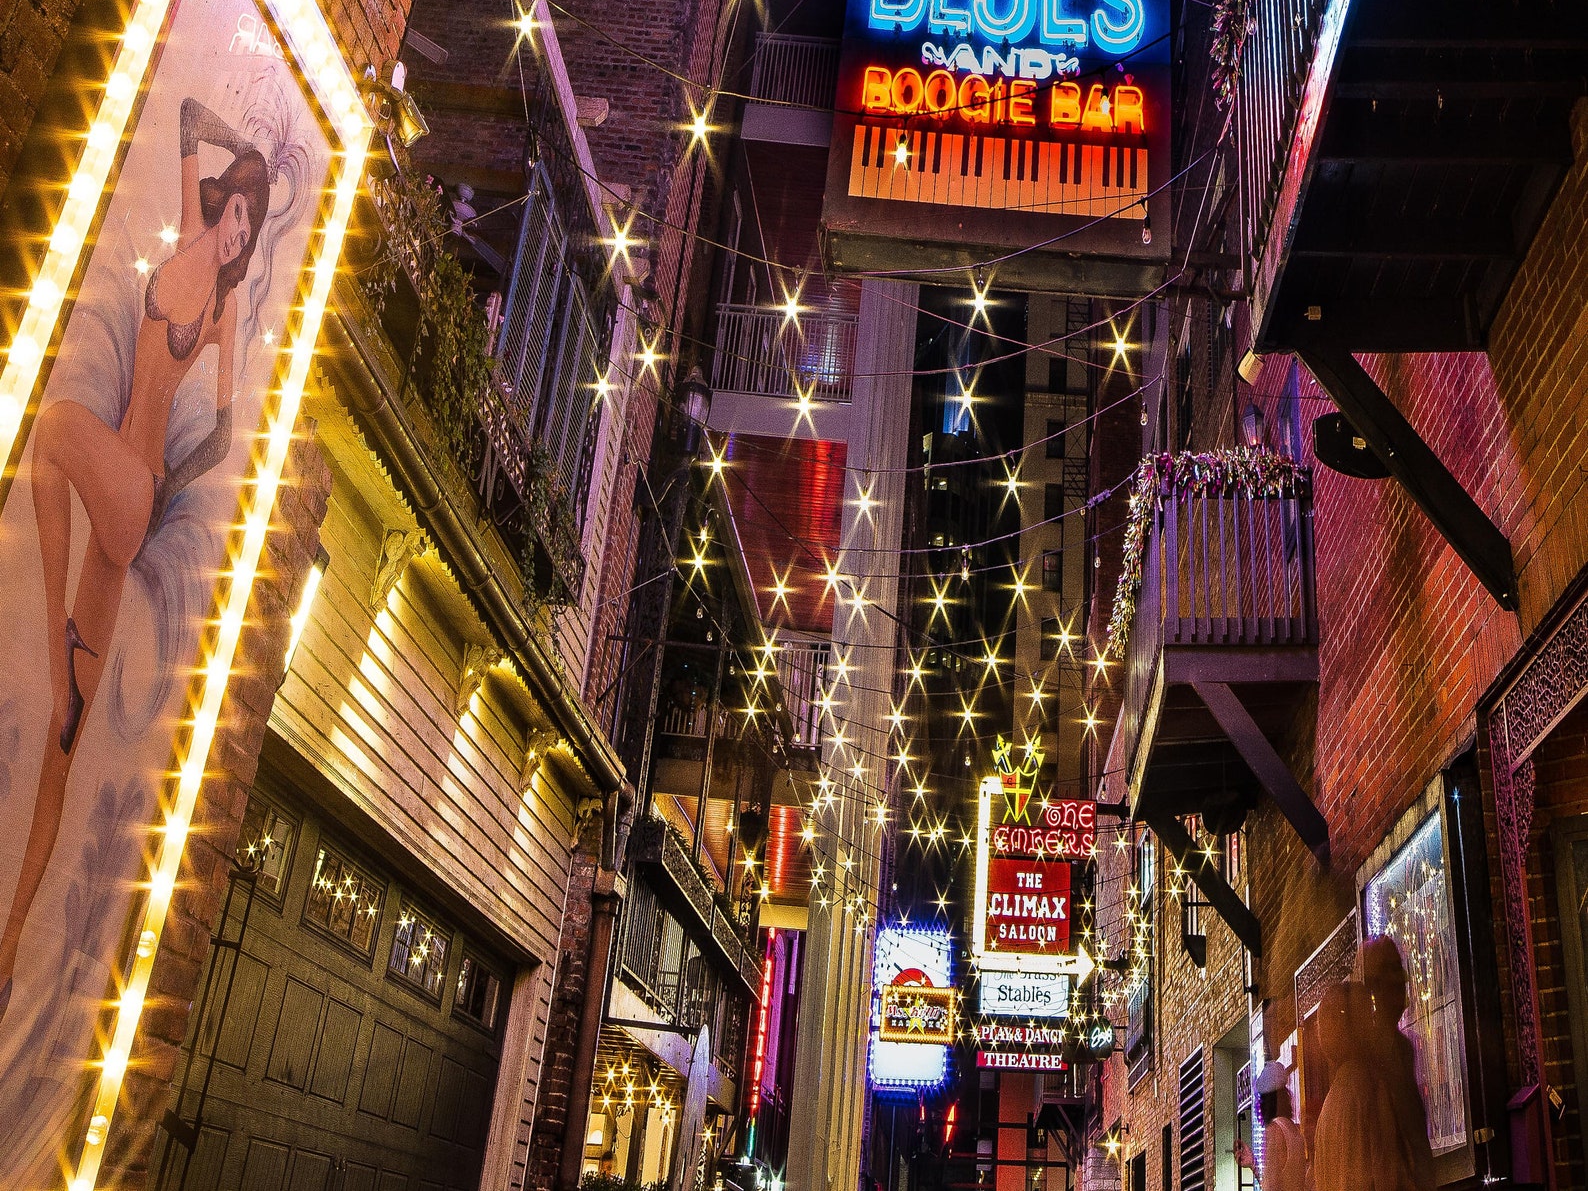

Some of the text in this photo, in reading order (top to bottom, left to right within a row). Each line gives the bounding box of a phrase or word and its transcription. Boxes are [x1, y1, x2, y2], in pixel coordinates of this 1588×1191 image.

[944, 43, 1054, 80] AND
[862, 66, 1146, 134] BOOGIE BAR
[1046, 802, 1095, 830] THE
[1016, 872, 1043, 889] THE
[991, 893, 1067, 920] CLIMAX
[999, 923, 1057, 942] SALOON
[997, 984, 1052, 1004] Stables
[981, 1025, 1013, 1041] PLAY
[1014, 1027, 1023, 1042] &
[983, 1052, 1063, 1069] THEATRE
